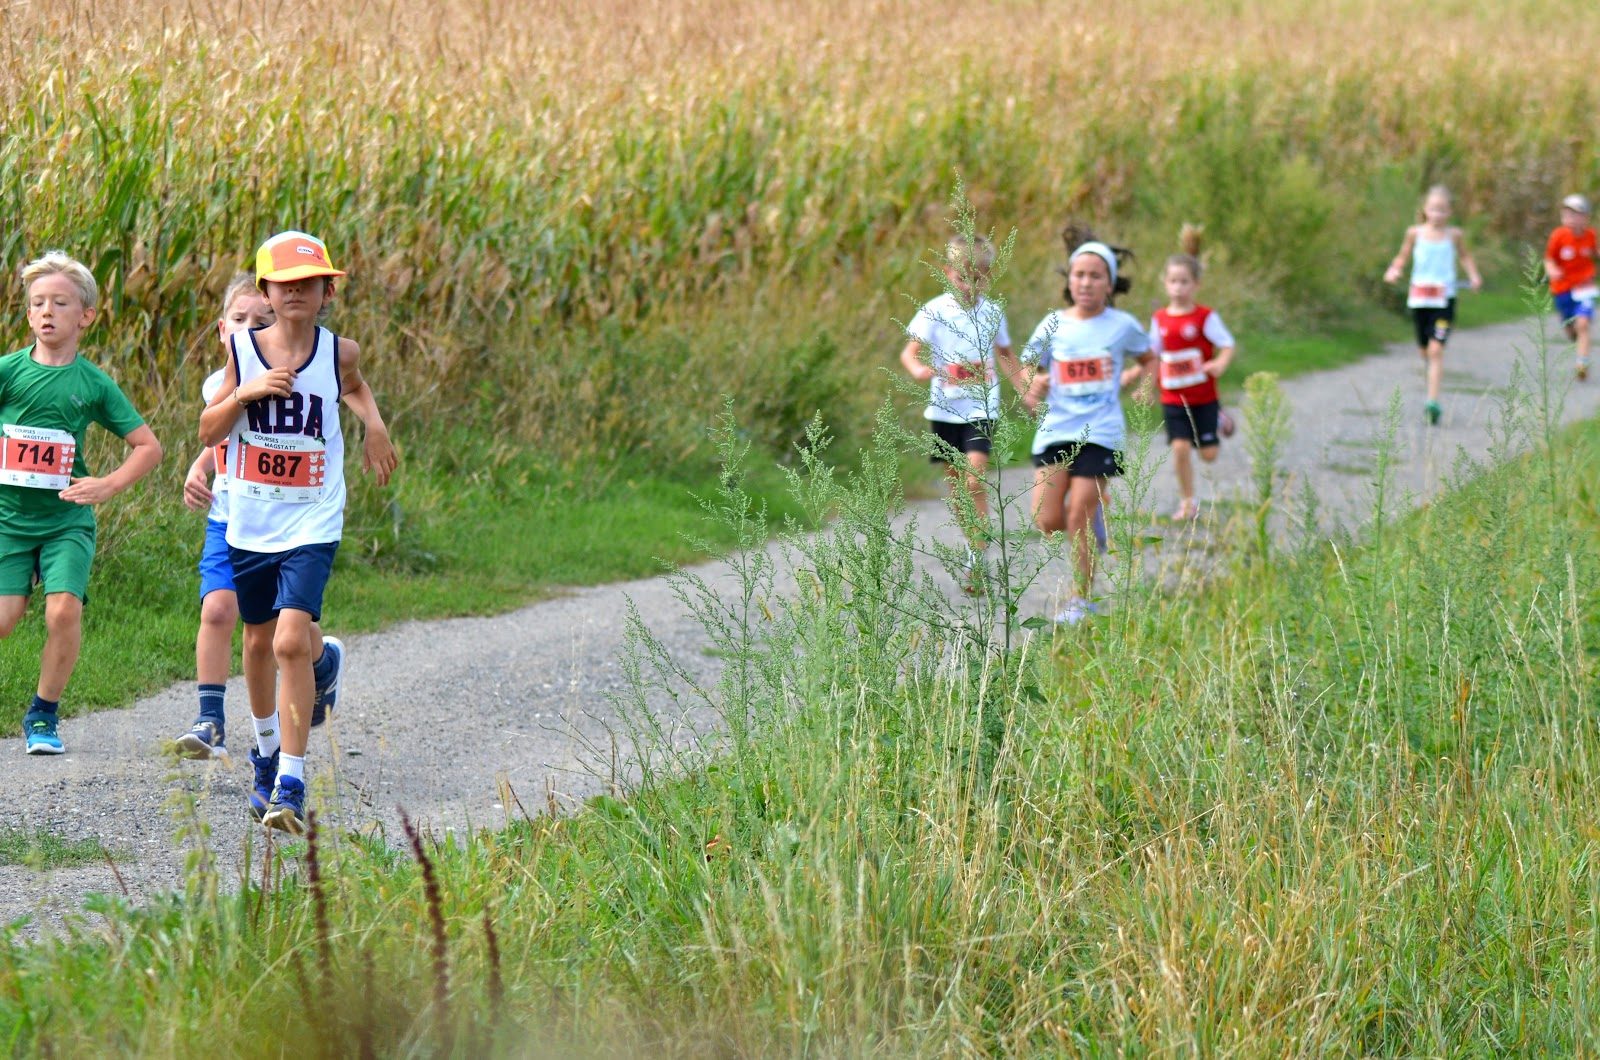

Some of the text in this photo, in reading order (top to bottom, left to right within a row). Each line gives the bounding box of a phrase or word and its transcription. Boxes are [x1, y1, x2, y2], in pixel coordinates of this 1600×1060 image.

[1066, 361, 1097, 378] 676
[247, 391, 323, 438] NBA
[254, 434, 279, 443] COURSES
[17, 443, 55, 466] 714
[257, 452, 302, 478] 687
